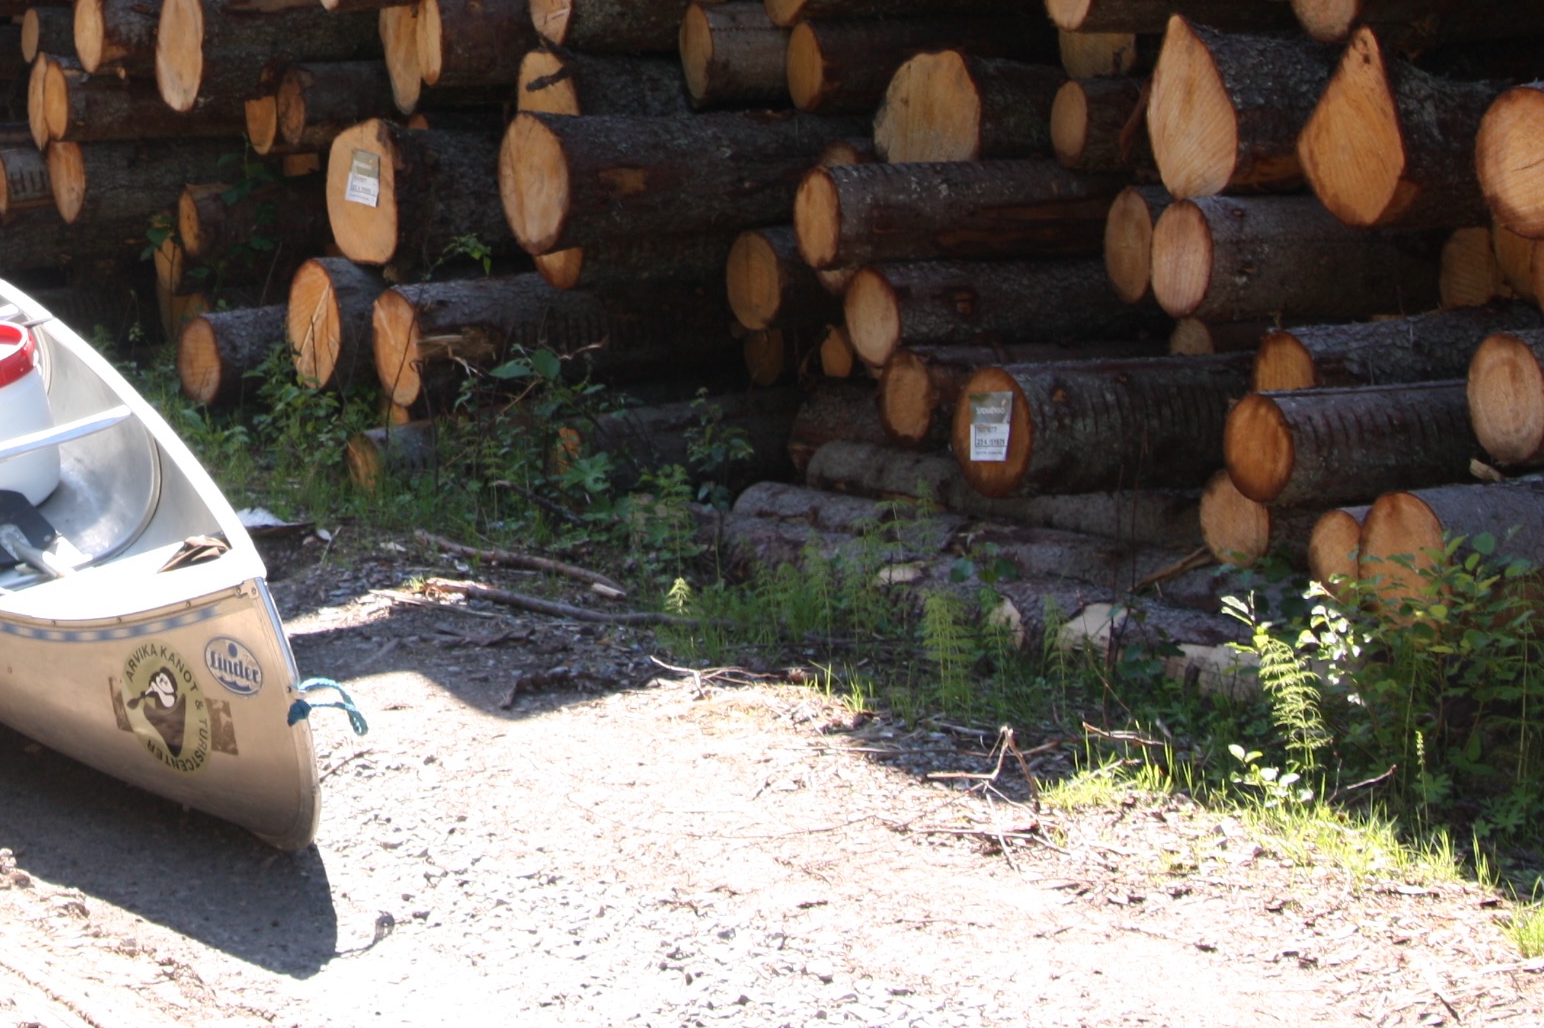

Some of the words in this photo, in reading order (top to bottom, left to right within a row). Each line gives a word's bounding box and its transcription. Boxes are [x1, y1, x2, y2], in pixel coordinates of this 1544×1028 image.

[125, 643, 158, 683] ARVIKA
[160, 645, 199, 693] KANOT
[209, 650, 260, 684] Linder
[195, 699, 204, 711] &
[146, 717, 209, 773] TURISTCENTER
